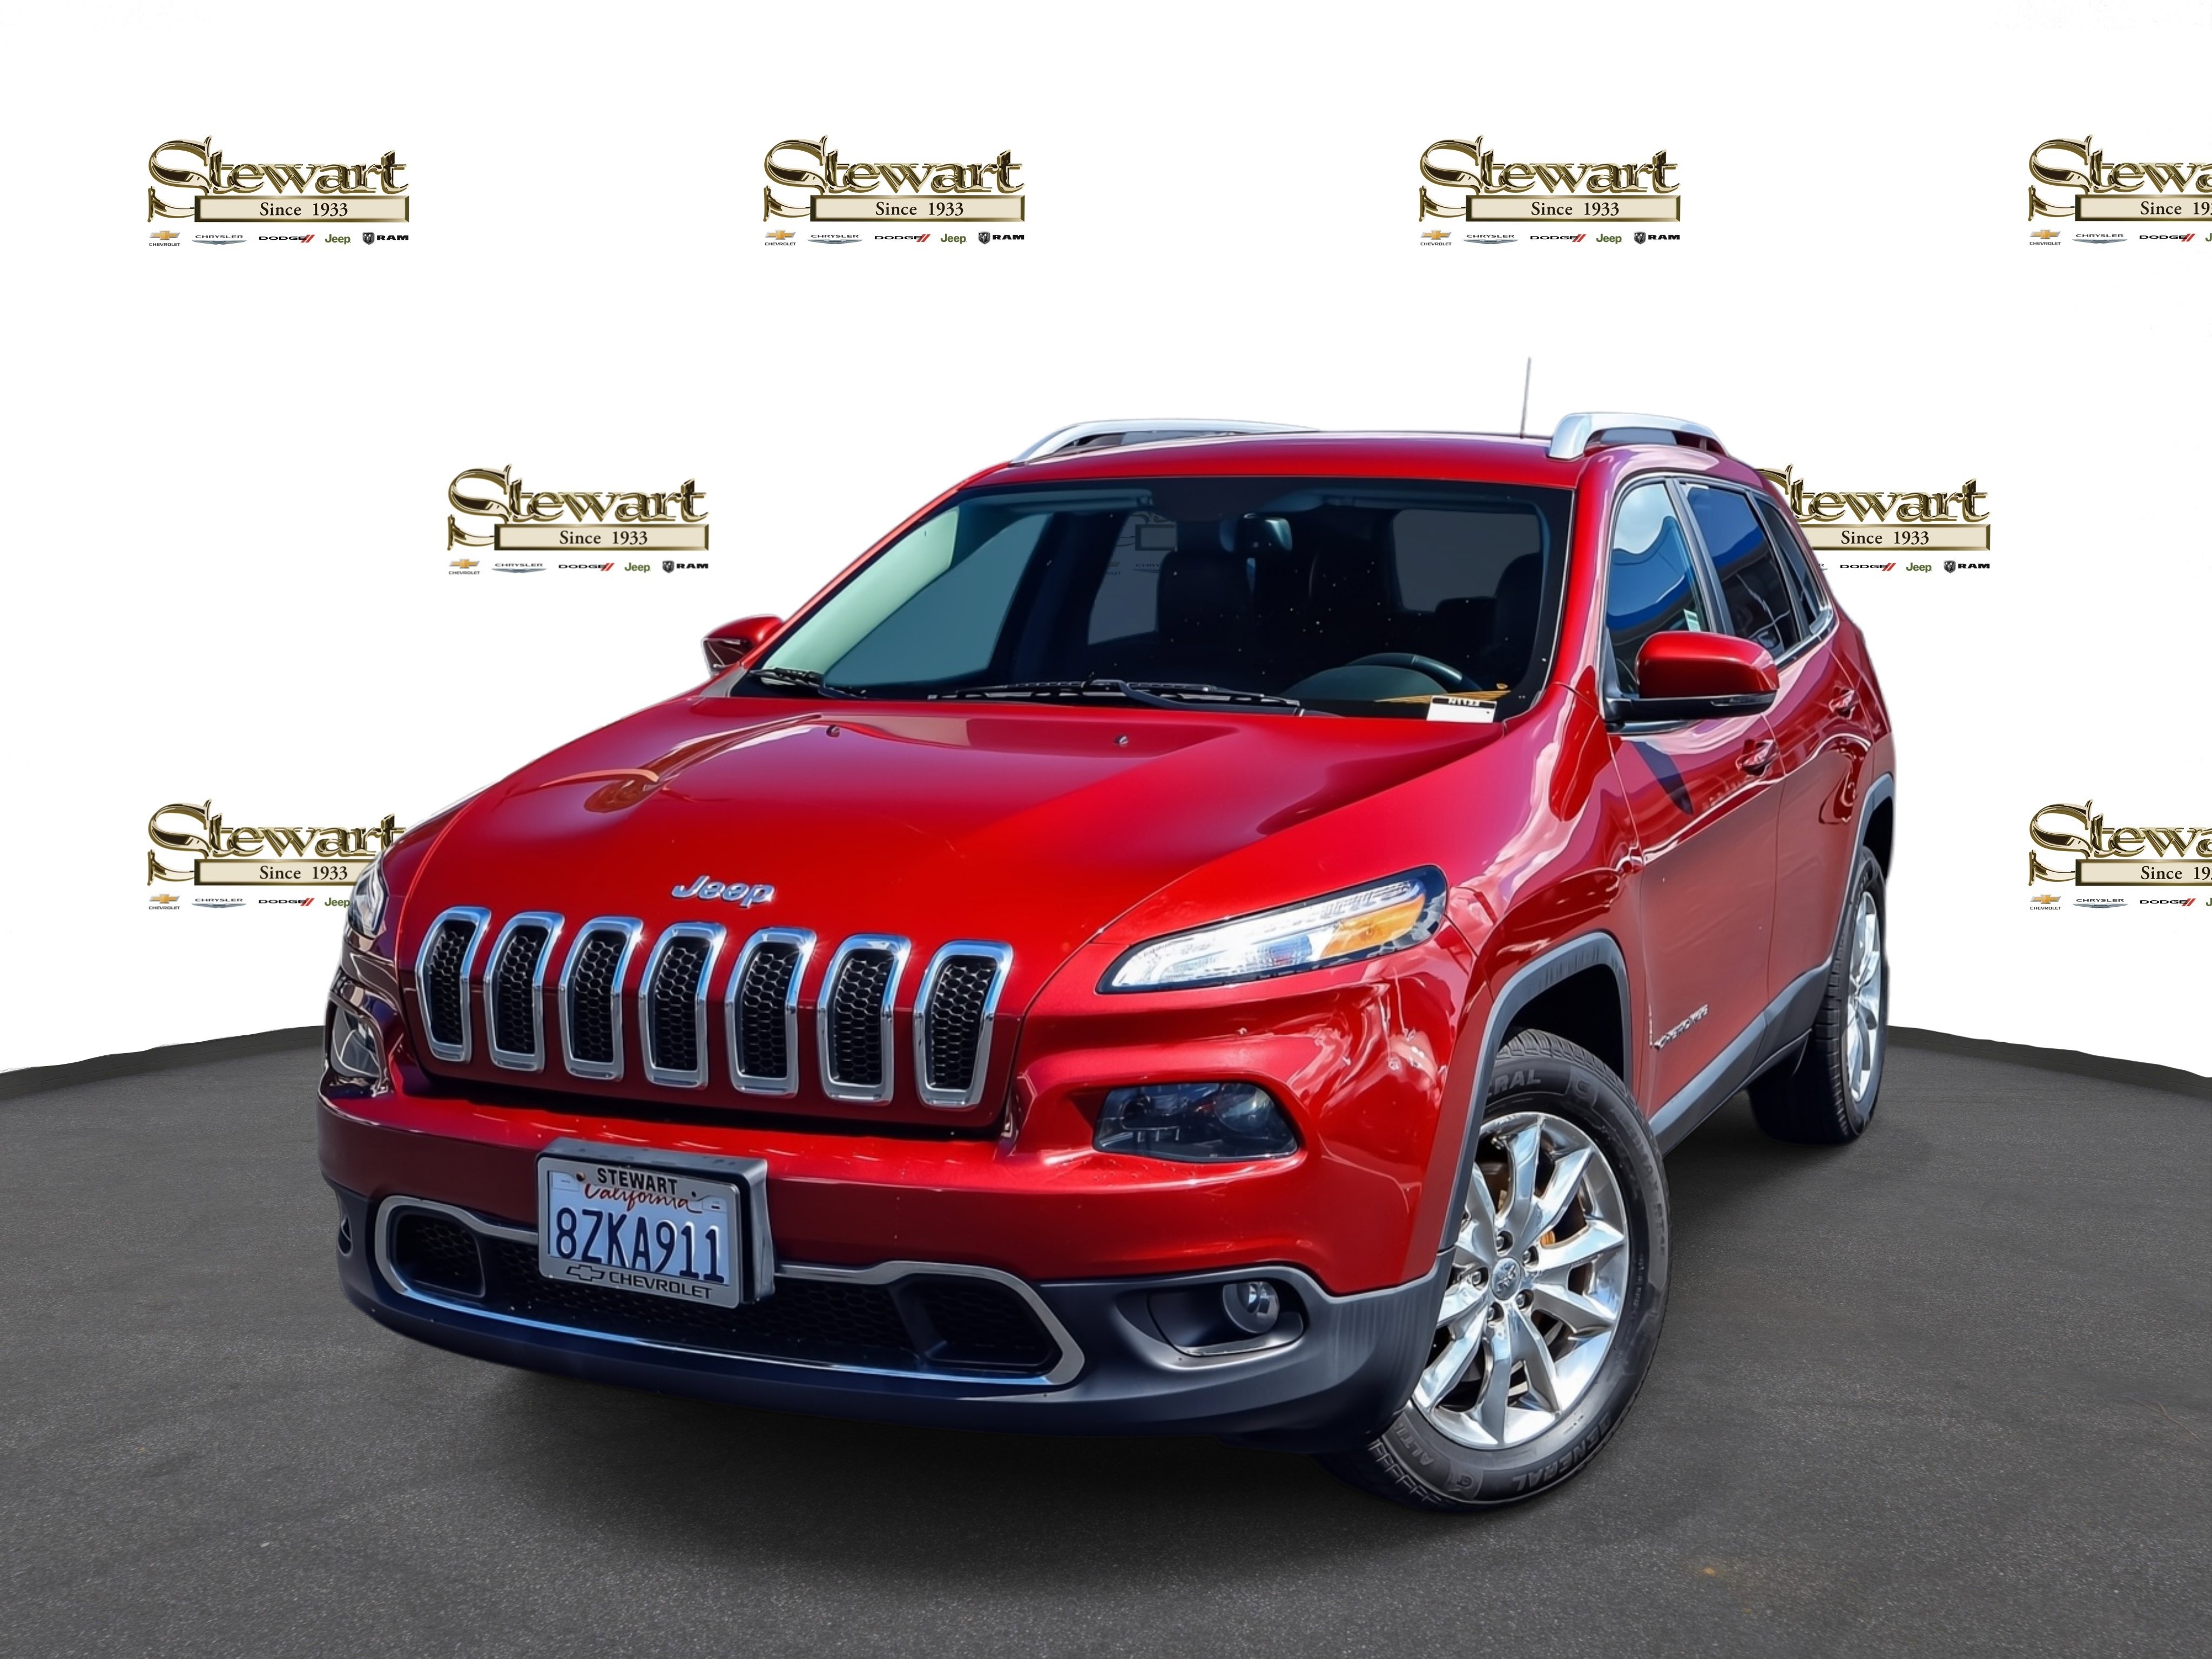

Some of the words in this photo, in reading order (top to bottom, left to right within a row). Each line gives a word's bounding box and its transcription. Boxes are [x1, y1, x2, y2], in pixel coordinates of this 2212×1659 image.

[146, 134, 410, 223] Stewart
[762, 134, 1026, 222] Stewart
[1418, 134, 1681, 222] Stewart
[259, 202, 302, 217] Since
[313, 203, 349, 217] 1933
[875, 201, 918, 216] Since
[928, 202, 965, 217] 1933
[1530, 201, 1573, 216] Since
[1584, 202, 1620, 217] 1933
[2140, 201, 2182, 216] Since
[2193, 202, 2212, 217] 19
[324, 233, 352, 245] Jeep
[940, 233, 967, 245] Jeep
[1595, 233, 1623, 245] Jeep
[446, 463, 710, 551] Stewart
[559, 530, 602, 545] Since
[612, 531, 649, 545] 1933
[1840, 530, 1883, 545] Since
[1894, 531, 1930, 545] 1933
[624, 562, 651, 574] Jeep
[1905, 562, 1933, 574] Jeep
[259, 866, 301, 880] Since
[312, 866, 348, 881] 1933
[2140, 866, 2183, 881] Since
[2194, 867, 2212, 881] 19
[671, 875, 775, 908] Jeep
[324, 897, 350, 908] Jeep
[597, 1167, 678, 1196] STEWART
[584, 1183, 703, 1212] California
[556, 1206, 725, 1284] 8ZKA911
[609, 1271, 713, 1299] CHEVROLET
